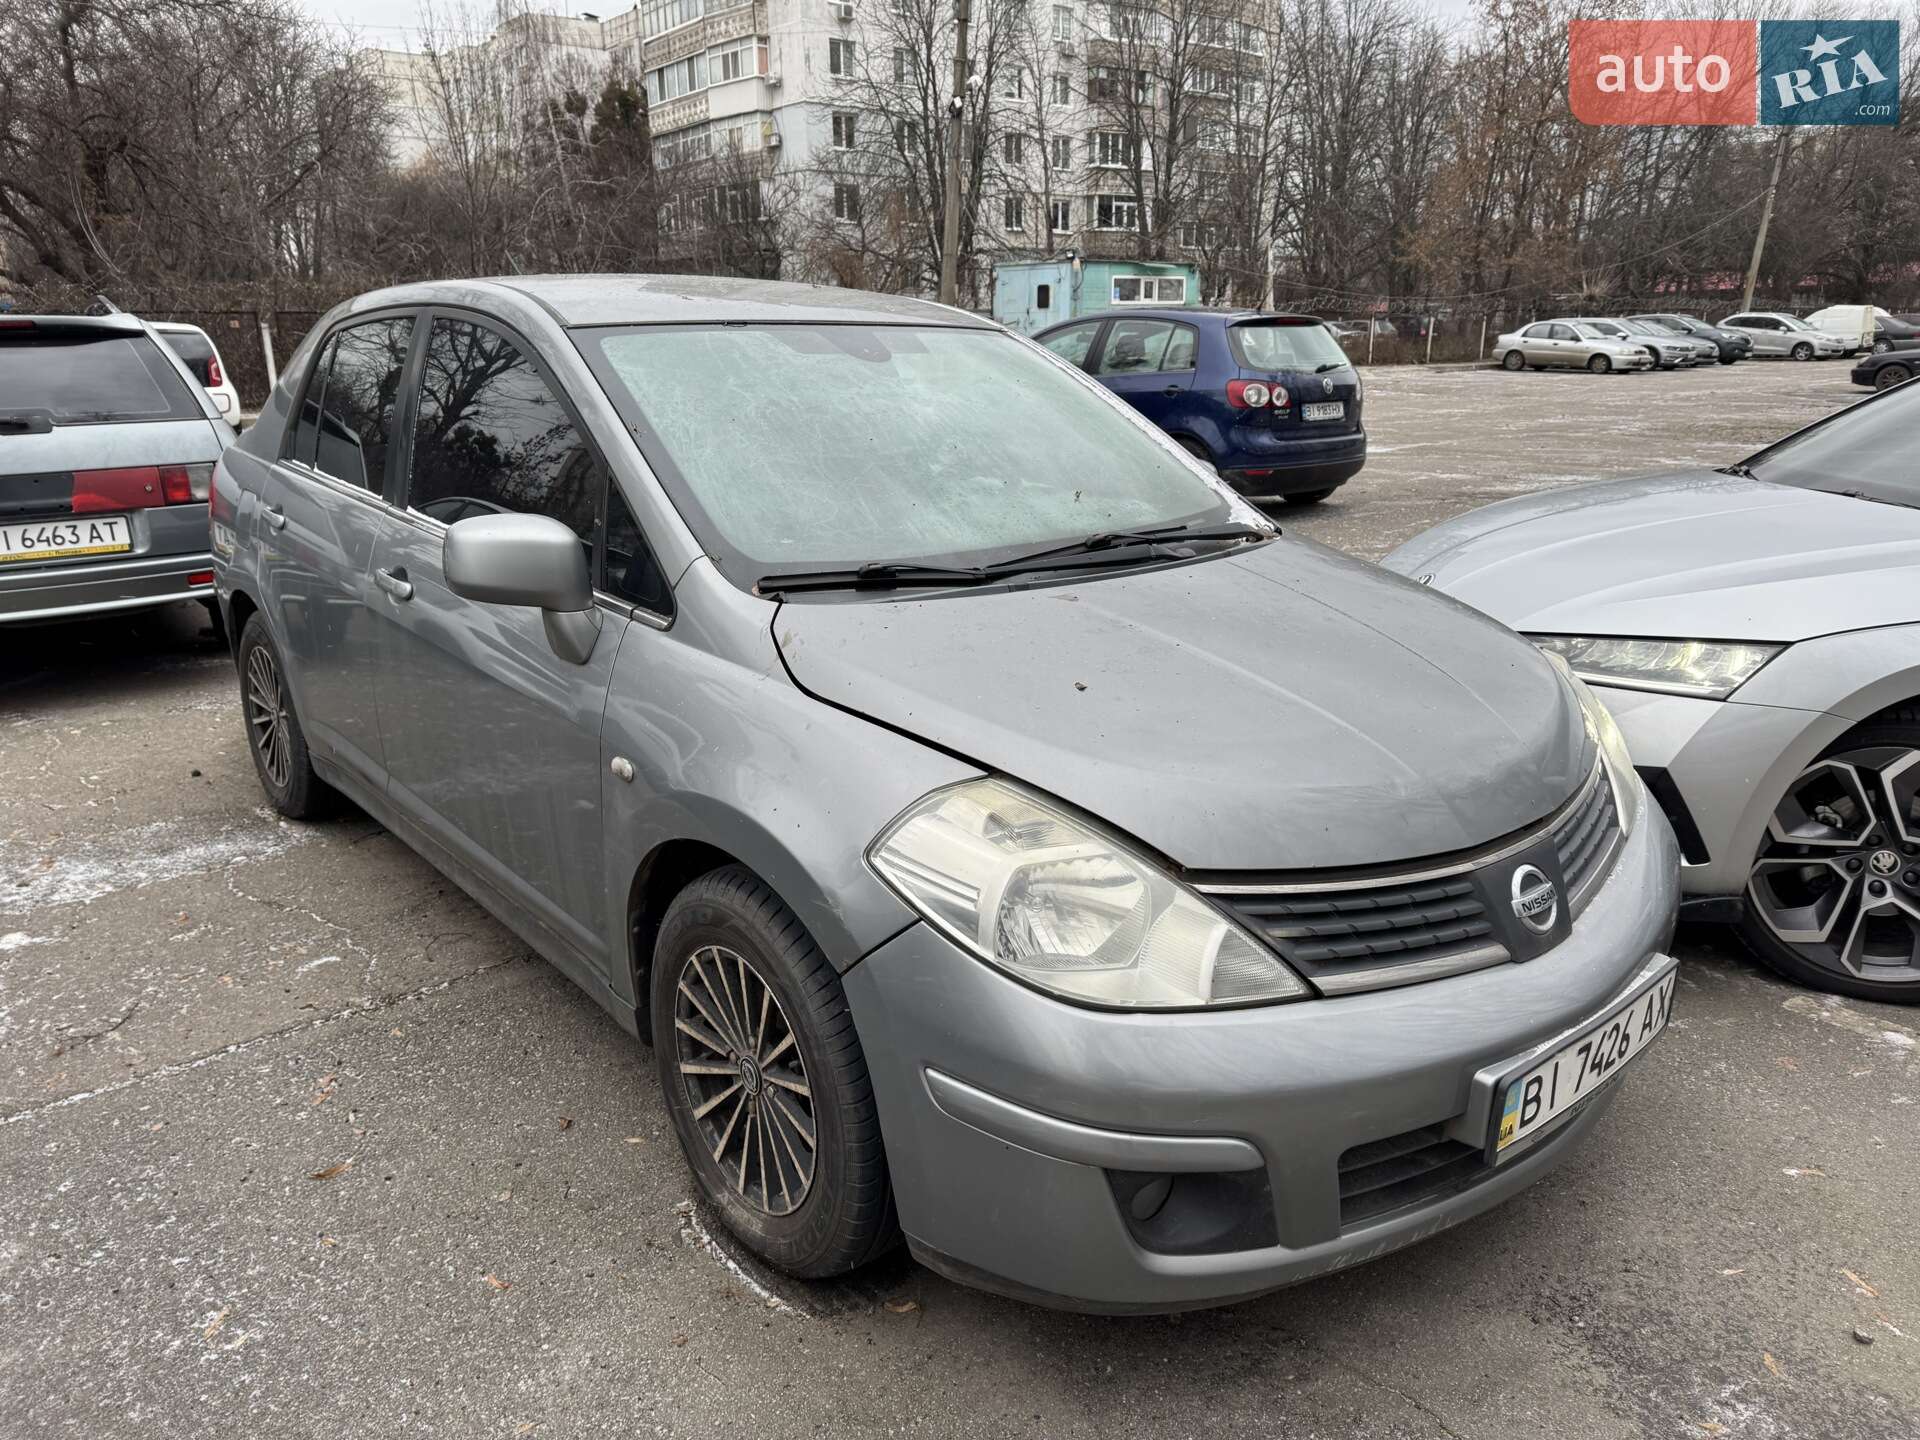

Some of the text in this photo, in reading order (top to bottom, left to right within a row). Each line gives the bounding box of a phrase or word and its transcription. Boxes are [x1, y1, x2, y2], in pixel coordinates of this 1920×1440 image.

[21, 524, 80, 549] 6463
[89, 521, 118, 543] AT
[1520, 889, 1556, 913] NISSAN
[1519, 1060, 1560, 1129] BI
[1574, 1010, 1634, 1094] 7426
[1638, 976, 1673, 1043] AX
